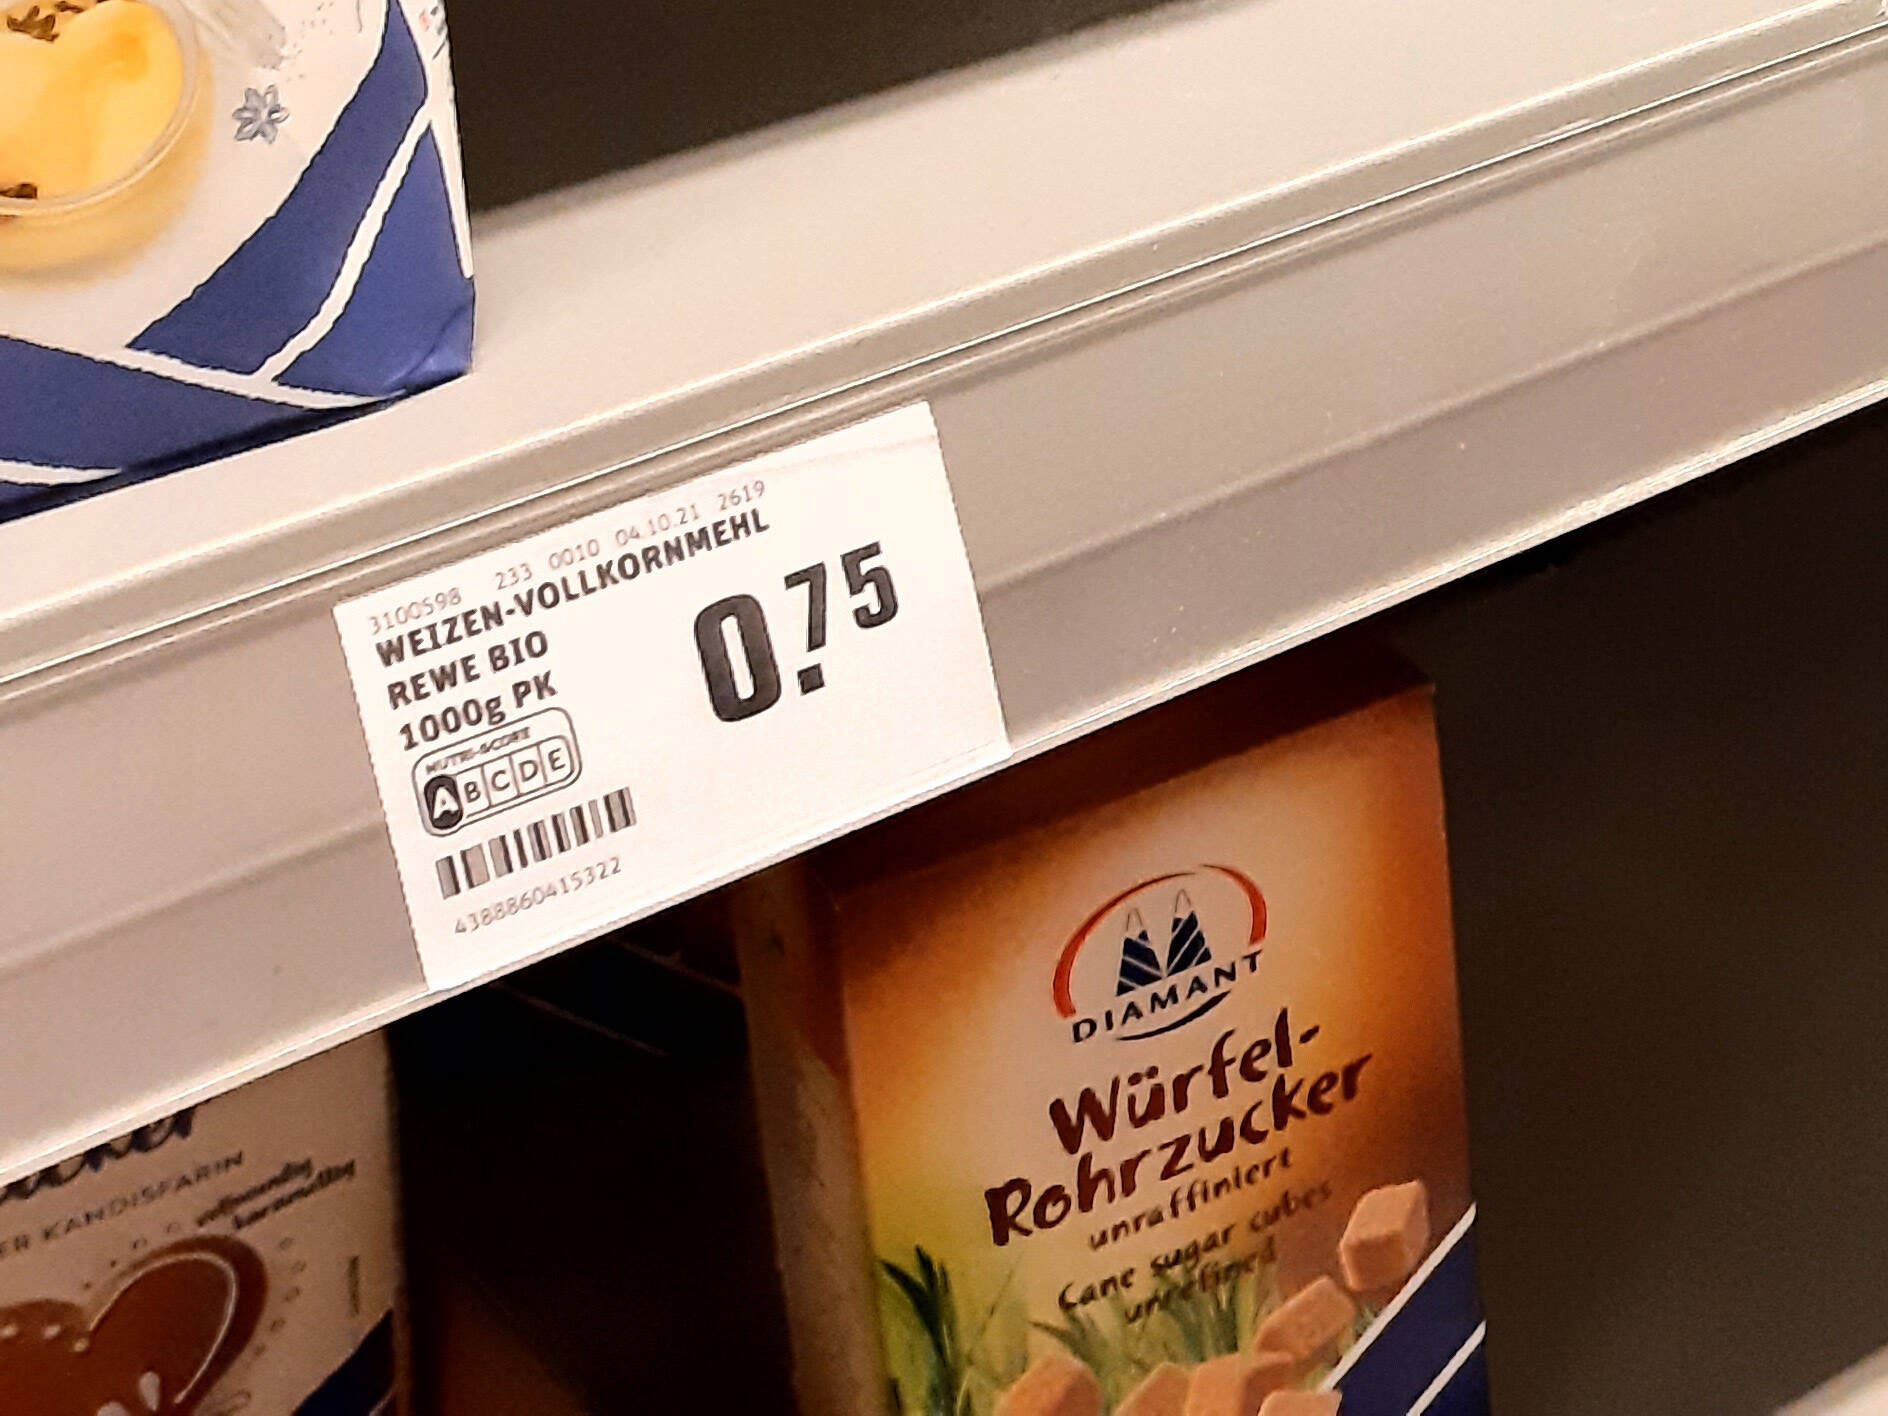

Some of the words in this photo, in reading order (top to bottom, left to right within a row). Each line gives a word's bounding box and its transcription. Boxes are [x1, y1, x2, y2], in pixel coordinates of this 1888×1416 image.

[369, 587, 463, 636] 3100598
[494, 562, 533, 591] 233
[548, 539, 600, 571] 0010
[615, 504, 702, 546] 04.10.21
[718, 479, 767, 512] 2619
[375, 507, 770, 668] WEIZEN-VOLLKORNMEHL
[387, 653, 482, 710] REWE
[487, 629, 549, 675] BIO
[693, 541, 899, 723] 0.75
[399, 697, 506, 751] 1000g
[511, 669, 558, 709] PK
[454, 856, 622, 935] 4388860415322
[1072, 948, 1266, 1044] DIAMANT
[1049, 1006, 1320, 1156] Würfel-
[41, 1150, 244, 1242] KANDISFARIN
[985, 1052, 1373, 1247] Rohrzucker
[1089, 1147, 1292, 1252] unraffiniert
[1150, 1224, 1236, 1271] sugar
[1249, 1181, 1332, 1233] cubes
